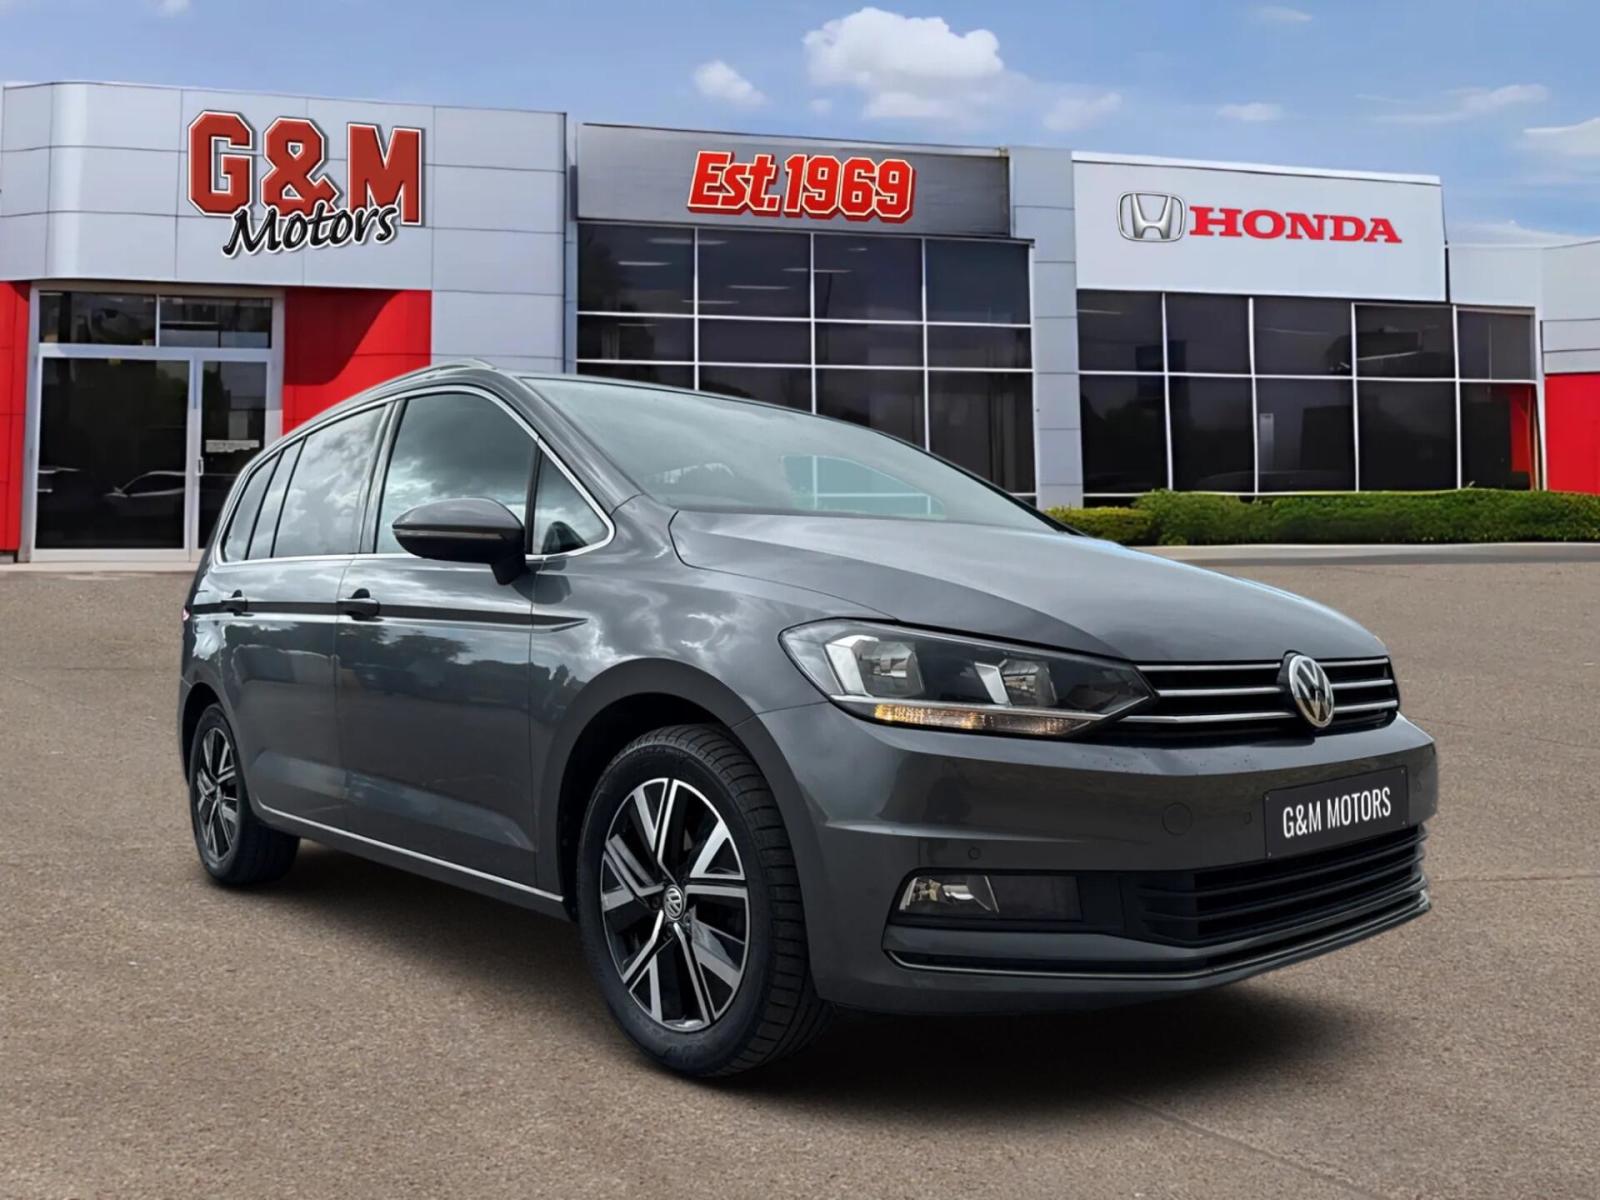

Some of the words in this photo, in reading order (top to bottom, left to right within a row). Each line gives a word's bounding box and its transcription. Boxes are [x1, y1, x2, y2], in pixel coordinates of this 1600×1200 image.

[187, 109, 425, 226] G&M
[222, 201, 399, 258] Motors
[1189, 205, 1403, 243] HONDA
[1283, 801, 1322, 838] G&M
[1327, 787, 1391, 829] MOTORS
